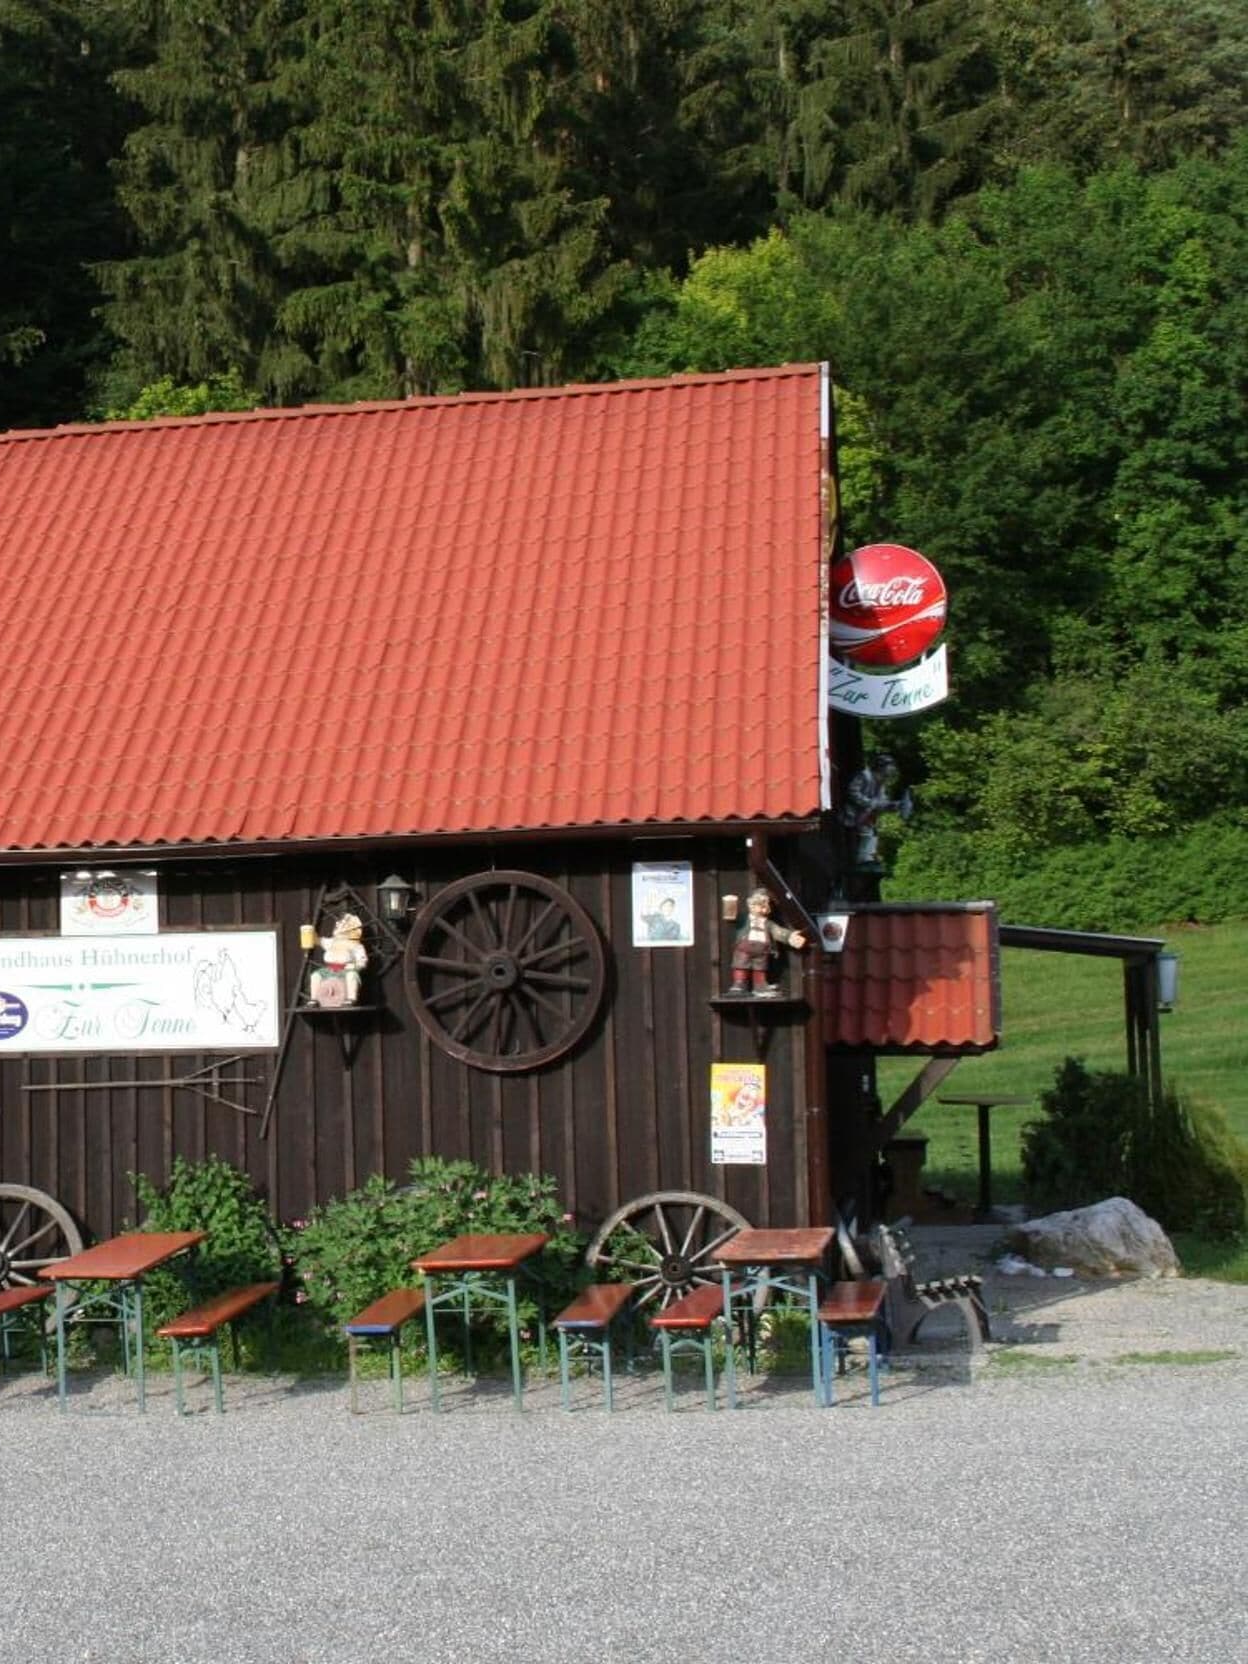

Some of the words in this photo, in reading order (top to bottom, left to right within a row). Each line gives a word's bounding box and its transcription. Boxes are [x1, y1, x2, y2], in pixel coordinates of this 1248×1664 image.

[839, 576, 928, 608] Coca-Cola
[80, 946, 196, 967] Hühnerhof
[35, 1000, 102, 1041] Zur
[114, 998, 197, 1040] Tenne
